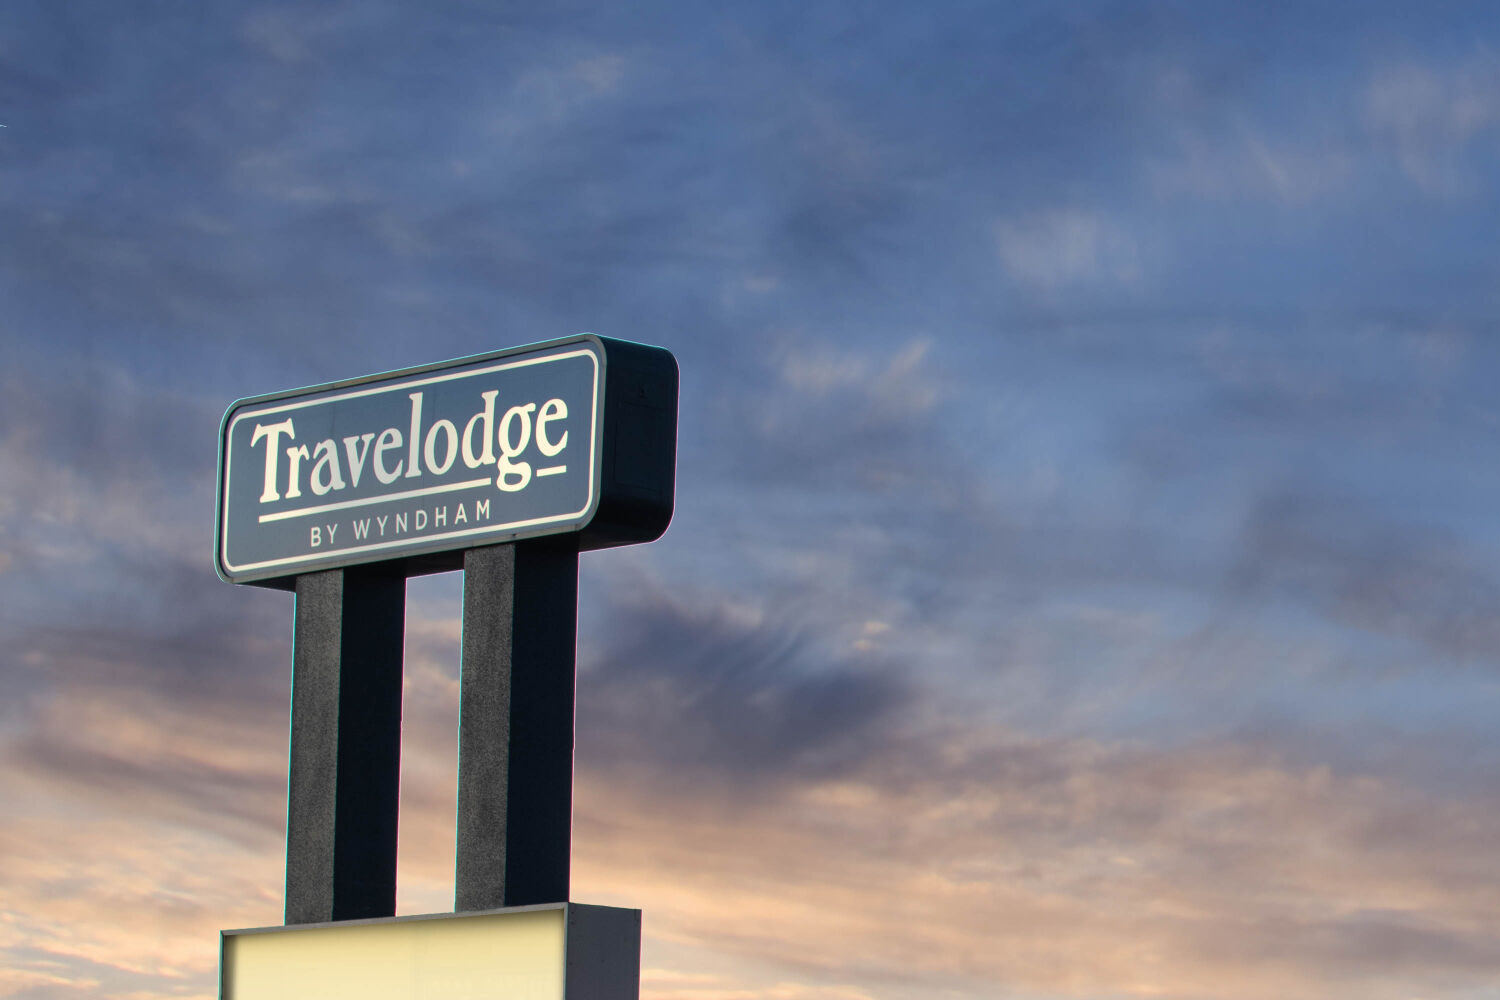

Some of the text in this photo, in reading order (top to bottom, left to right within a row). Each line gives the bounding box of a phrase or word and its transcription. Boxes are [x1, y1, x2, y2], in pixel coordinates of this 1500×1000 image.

[251, 390, 569, 504] Travelodge
[310, 498, 491, 548] BY WYNDHAM
